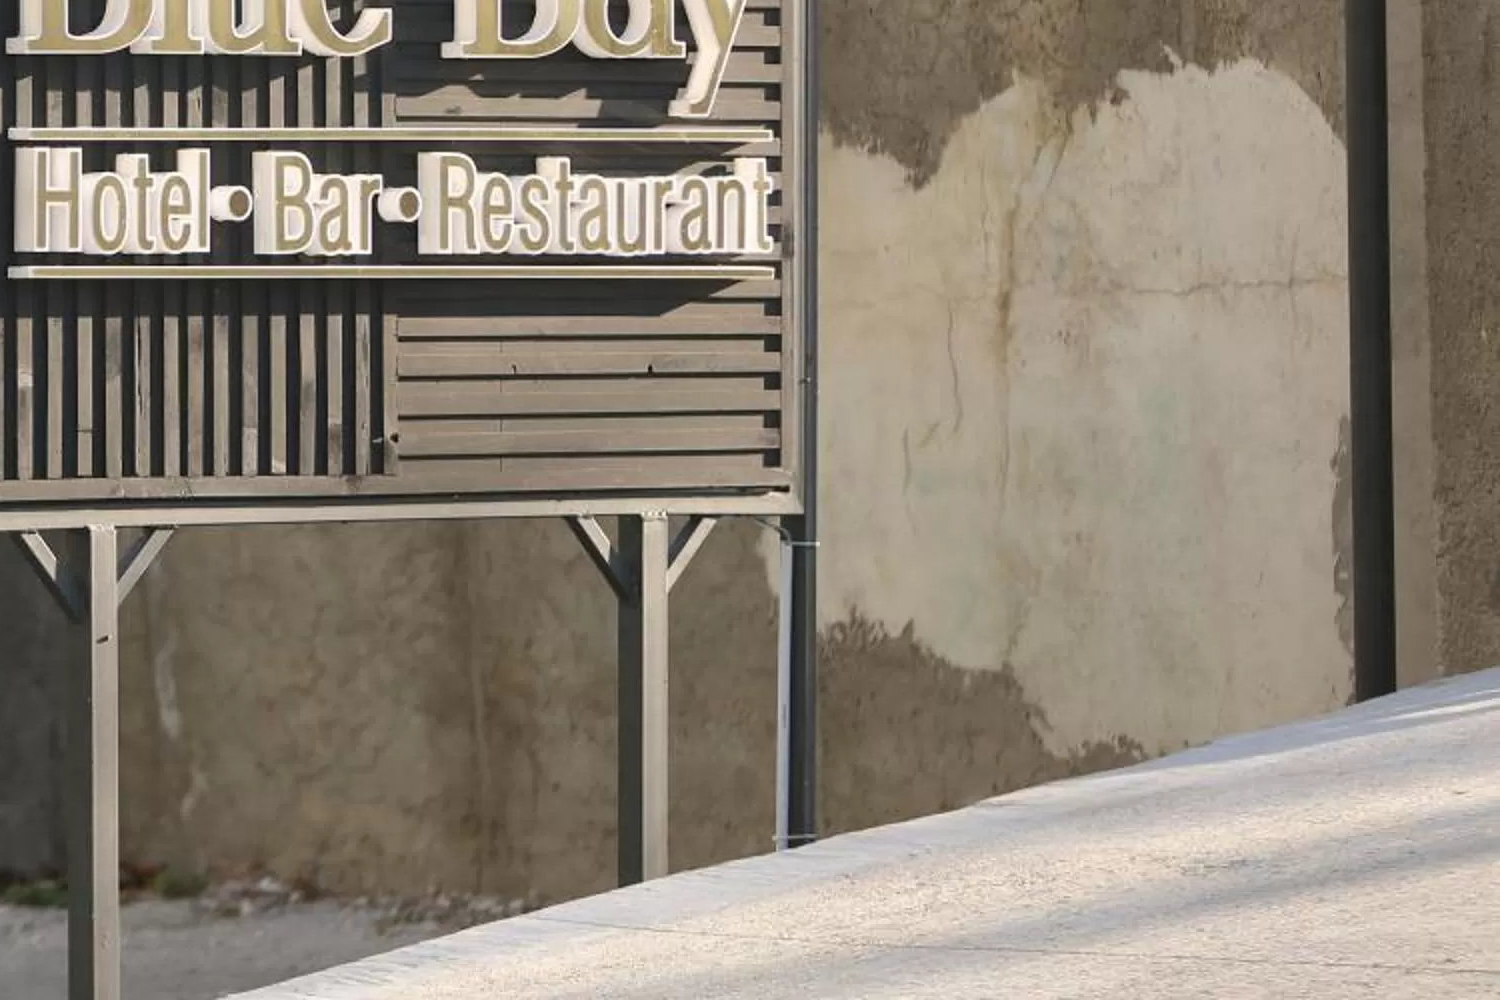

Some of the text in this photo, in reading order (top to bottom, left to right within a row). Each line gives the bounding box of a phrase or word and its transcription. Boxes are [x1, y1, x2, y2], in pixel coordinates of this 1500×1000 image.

[14, 147, 773, 256] Hotel Bar Restaurant
